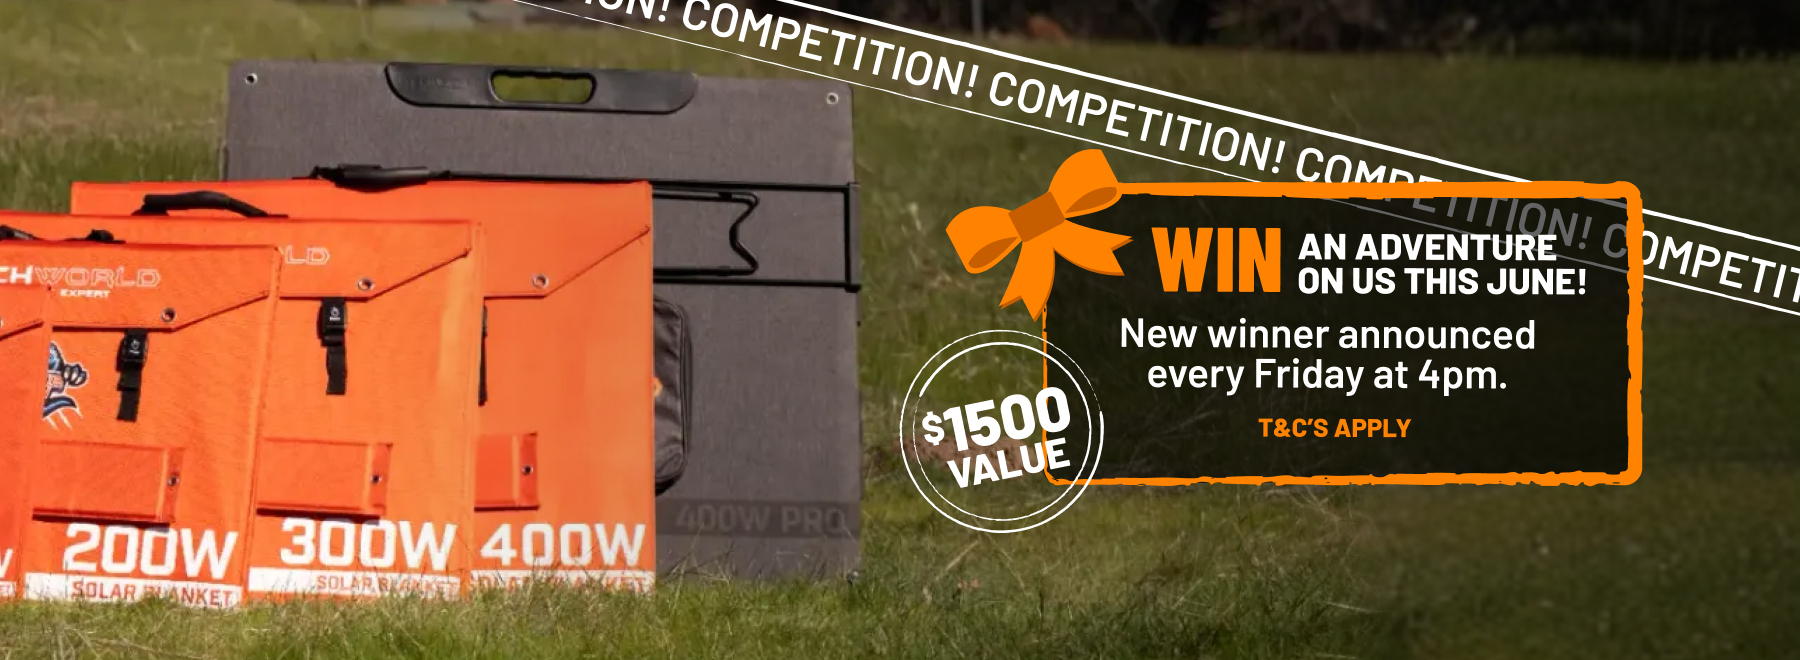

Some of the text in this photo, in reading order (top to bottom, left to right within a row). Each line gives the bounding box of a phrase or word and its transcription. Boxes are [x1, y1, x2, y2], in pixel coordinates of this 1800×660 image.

[60, 289, 111, 299] EXPERT
[676, 503, 846, 534] 400W PRO
[62, 523, 238, 580] 200W
[280, 517, 458, 571] 300W
[480, 523, 646, 567] 400W
[71, 580, 136, 600] SOLAR
